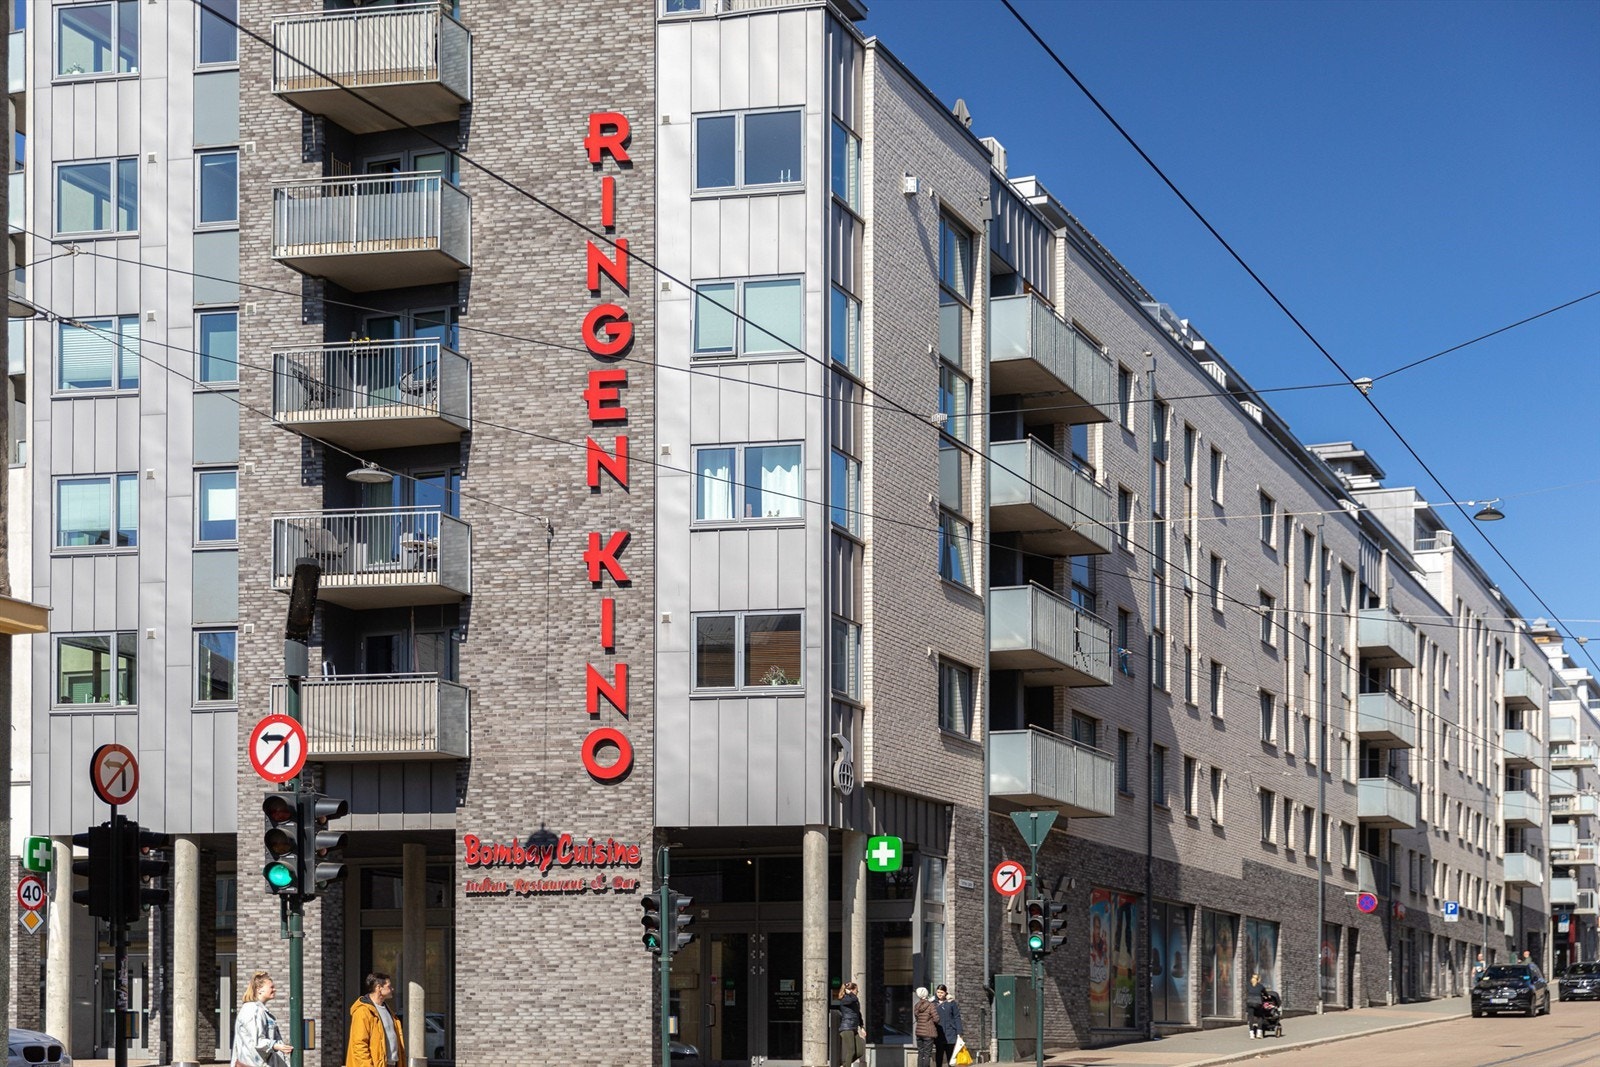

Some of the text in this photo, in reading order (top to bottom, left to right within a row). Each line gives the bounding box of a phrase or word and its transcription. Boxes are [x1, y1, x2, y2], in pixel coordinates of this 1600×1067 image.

[581, 112, 634, 780] RINGEN KINO
[464, 833, 642, 872] Bombay Cuisine
[23, 885, 41, 902] 40
[465, 877, 507, 893] Indian
[513, 878, 585, 894] Restaurant
[612, 876, 638, 890] Bar
[1447, 904, 1456, 914] P
